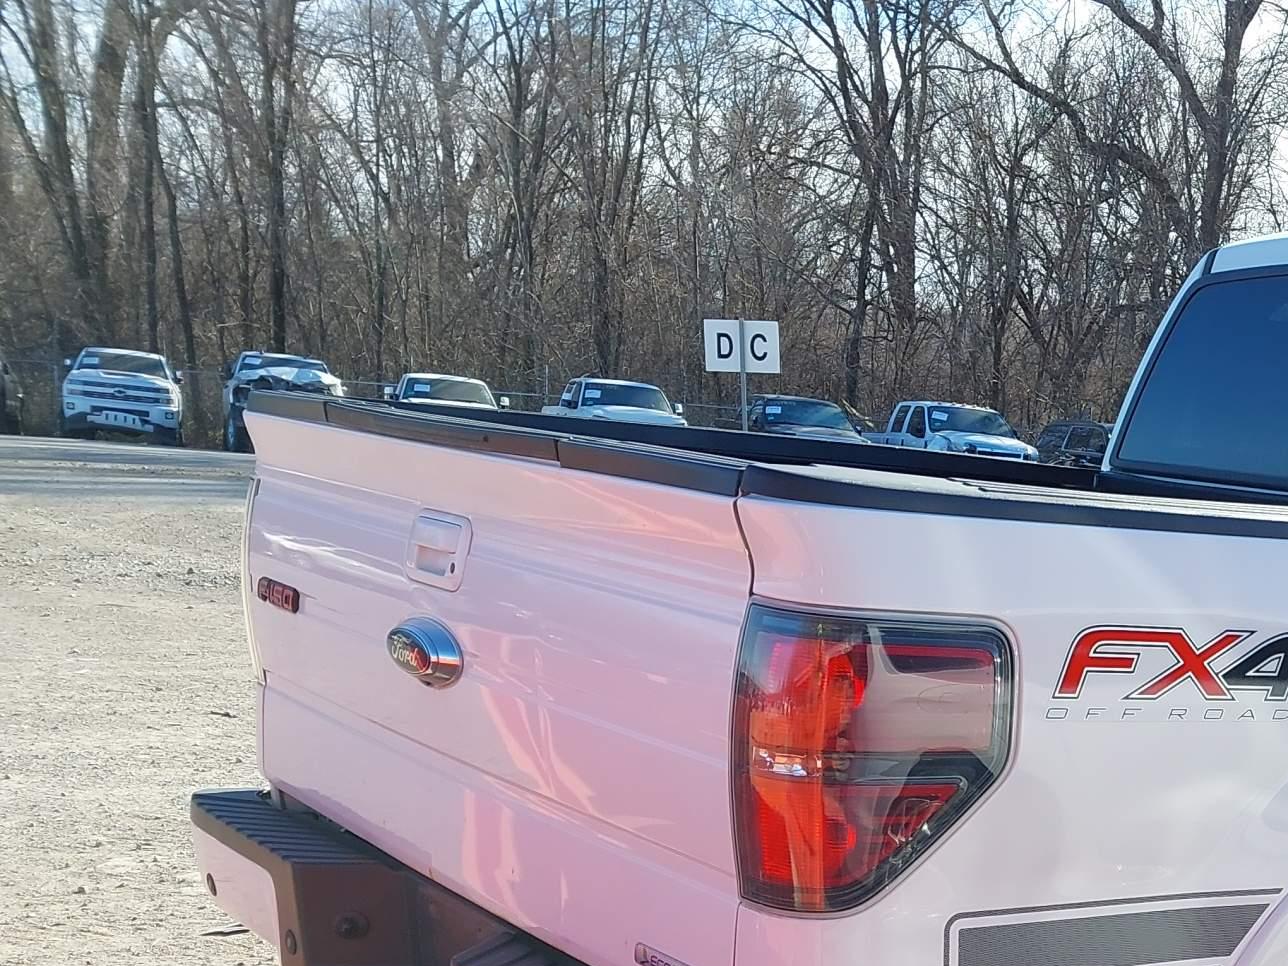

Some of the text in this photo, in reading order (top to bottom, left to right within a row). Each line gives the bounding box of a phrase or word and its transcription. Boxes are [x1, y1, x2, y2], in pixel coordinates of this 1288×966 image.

[716, 332, 733, 360] D
[749, 333, 768, 362] C
[390, 634, 419, 668] Ford
[1045, 707, 1143, 720] OFF
